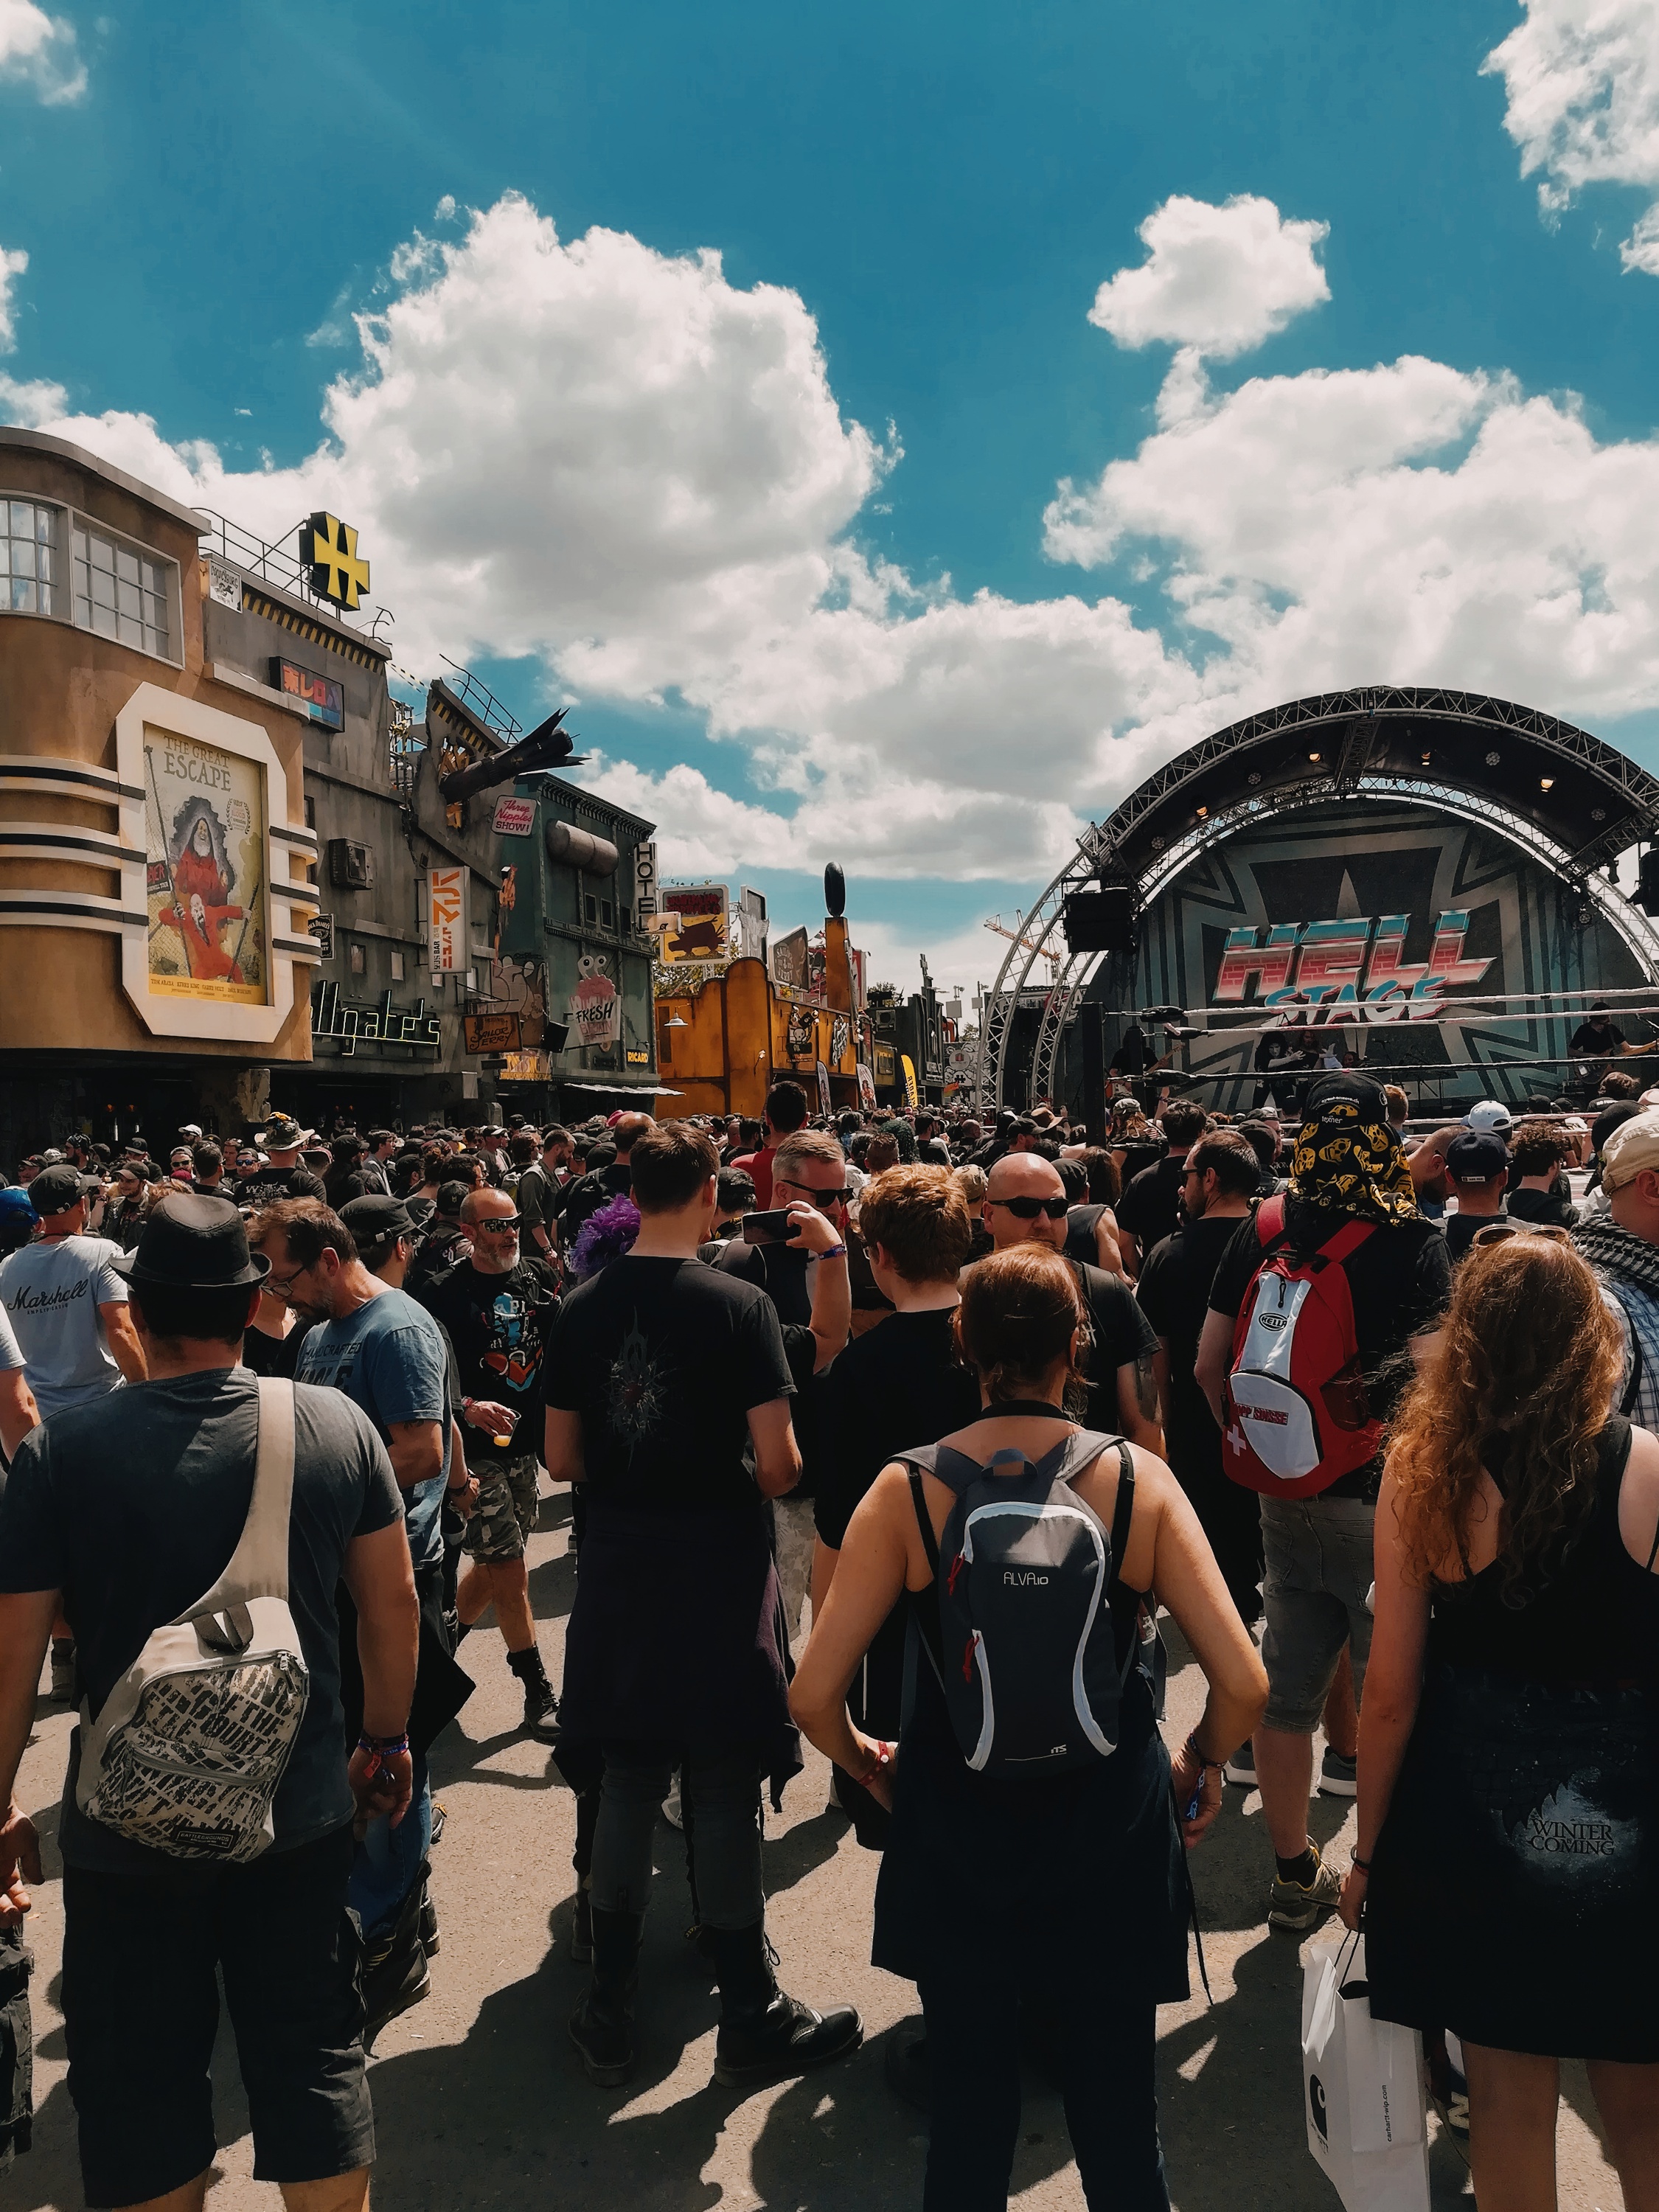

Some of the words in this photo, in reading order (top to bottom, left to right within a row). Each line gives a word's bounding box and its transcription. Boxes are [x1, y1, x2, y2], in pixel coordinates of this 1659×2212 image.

[164, 736, 189, 755] THE
[192, 745, 229, 768] GREAT
[164, 751, 231, 792] ESCAPE
[495, 808, 532, 822] Nipples
[504, 800, 530, 812] Three
[636, 843, 655, 933] HOTEL
[1212, 908, 1498, 1001] HELL
[576, 1000, 615, 1023] FRESH
[1262, 975, 1448, 1028] STAGE
[310, 980, 440, 1056] llgate's
[469, 1031, 512, 1050] JERRY
[470, 1026, 509, 1043] SAILOR
[627, 1051, 649, 1063] RICARD
[7, 1279, 88, 1311] Marshall
[1261, 1315, 1288, 1328] HELLA
[180, 1832, 230, 1843] BATTLEGROUNDS
[1531, 1818, 1613, 1841] WINTER
[1528, 1835, 1615, 1856] COMING
[1382, 2084, 1392, 2143] carhartt-wip.com
